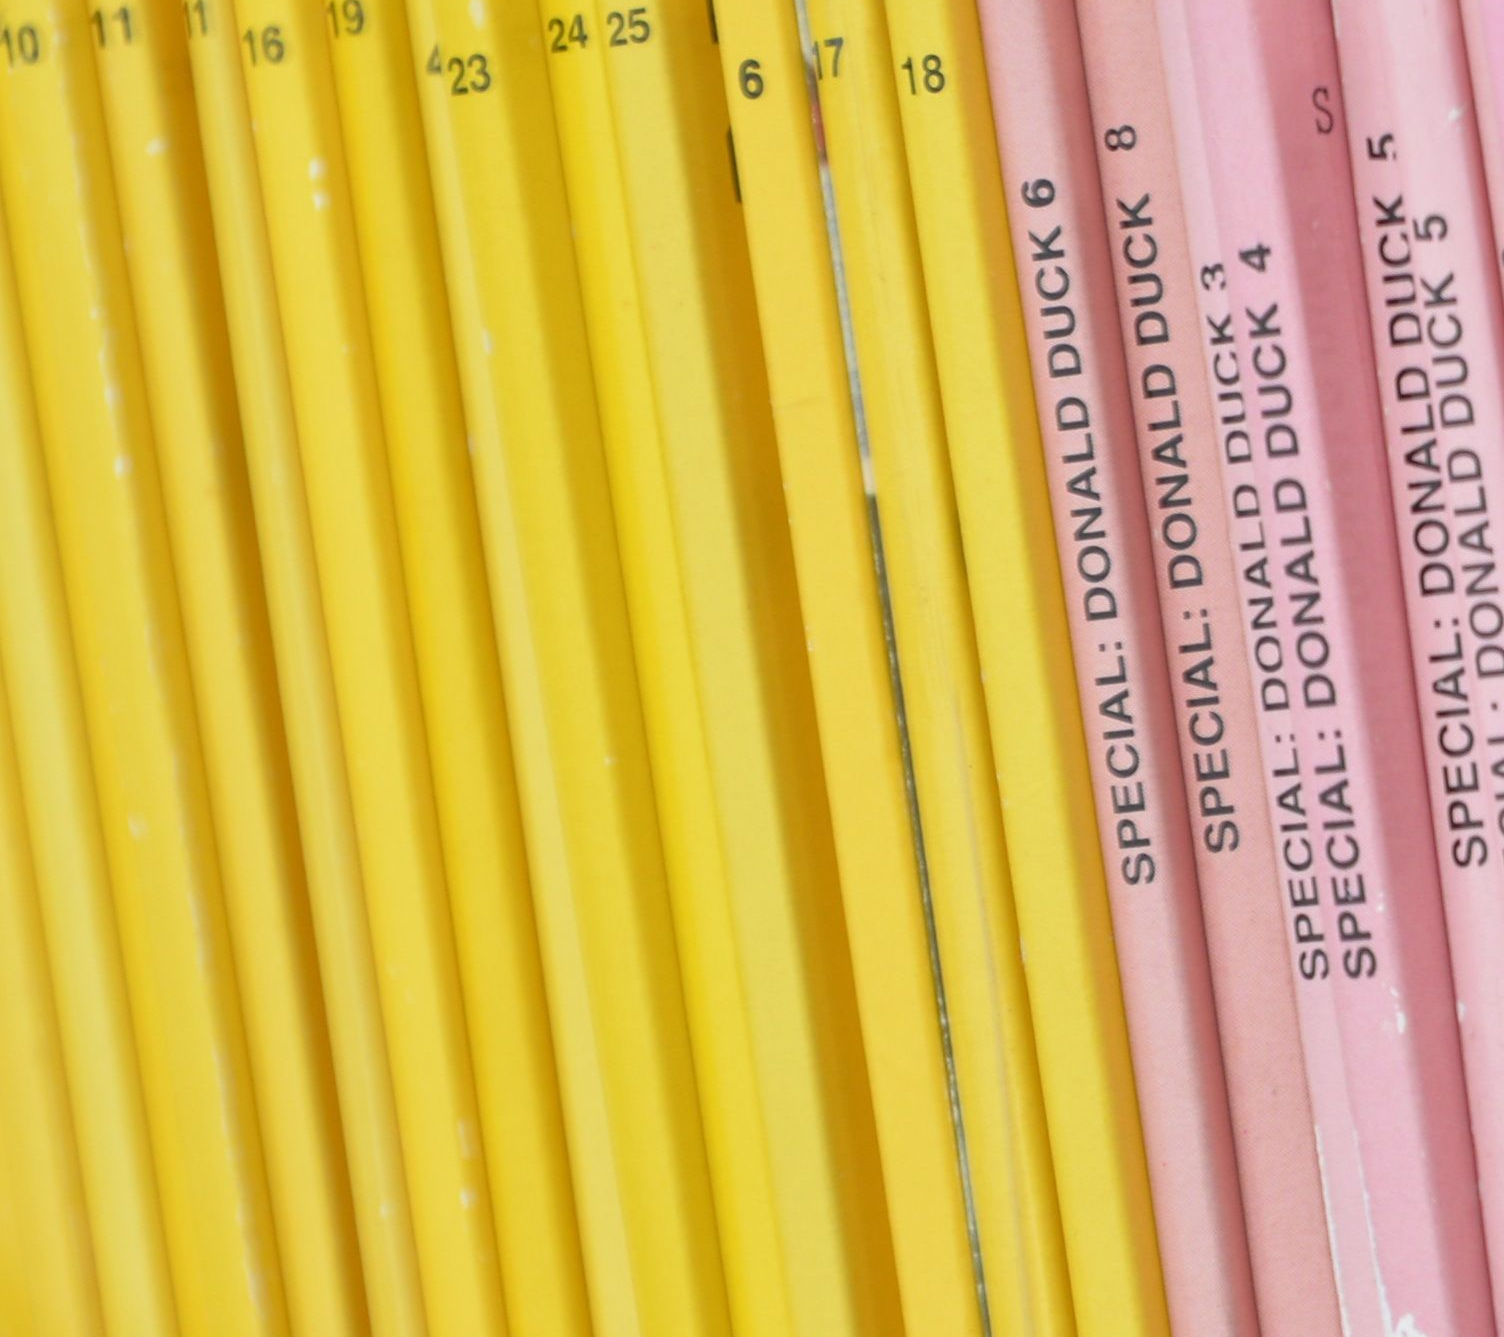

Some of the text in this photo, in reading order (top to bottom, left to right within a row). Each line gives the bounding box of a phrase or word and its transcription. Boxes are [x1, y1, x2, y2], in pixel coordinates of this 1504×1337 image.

[0, 24, 40, 68] 10
[91, 6, 133, 50] 11
[242, 25, 285, 68] 16
[547, 14, 589, 54] 24
[606, 7, 651, 48] 25
[447, 53, 493, 96] 23
[738, 58, 765, 100] 6
[812, 36, 845, 81] 17
[901, 53, 946, 96] 18
[1413, 214, 1449, 242] 5
[1419, 272, 1476, 428] DUCK
[1104, 124, 1239, 853] SPECIAL: DONALD DUCK 8
[1366, 132, 1487, 868] SPECIAL: DONALD DUCK 5
[1021, 177, 1156, 886] SPECIAL: DONALD DUCK 6
[1200, 263, 1329, 980] SPECIAL: DONALD DUCK 3
[1238, 242, 1377, 979] SPECIAL: DONALD DUCK 4
